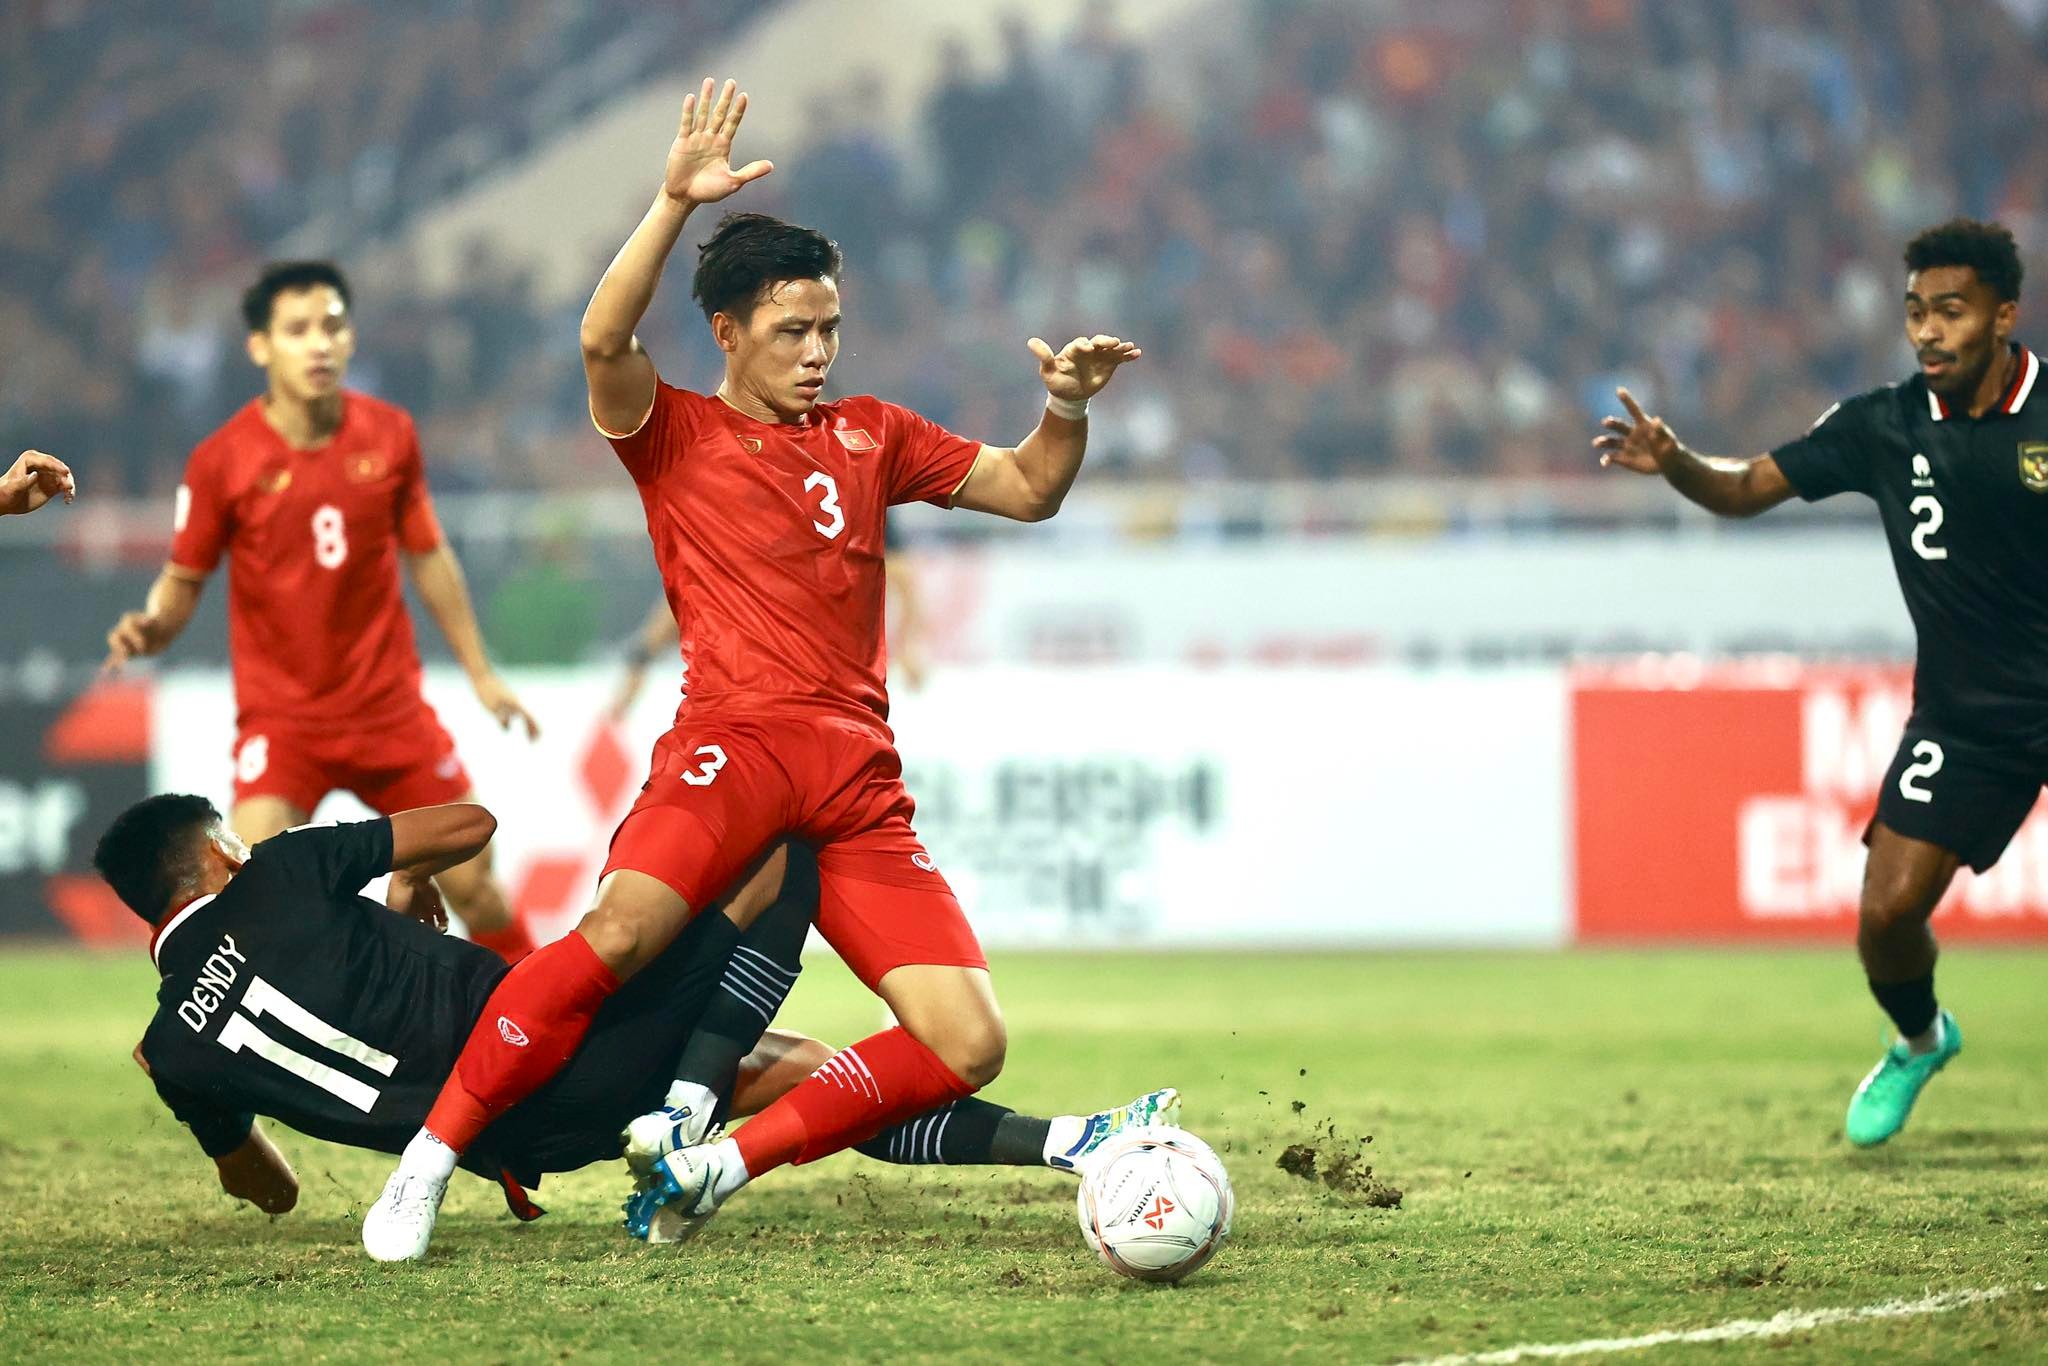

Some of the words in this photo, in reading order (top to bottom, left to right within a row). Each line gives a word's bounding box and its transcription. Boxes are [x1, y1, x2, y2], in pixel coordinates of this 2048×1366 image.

[311, 504, 348, 569] 8
[804, 471, 846, 540] 3
[1909, 495, 1948, 560] 2
[680, 744, 728, 786] 3
[1899, 739, 1944, 803] 2
[216, 975, 399, 1114] 11
